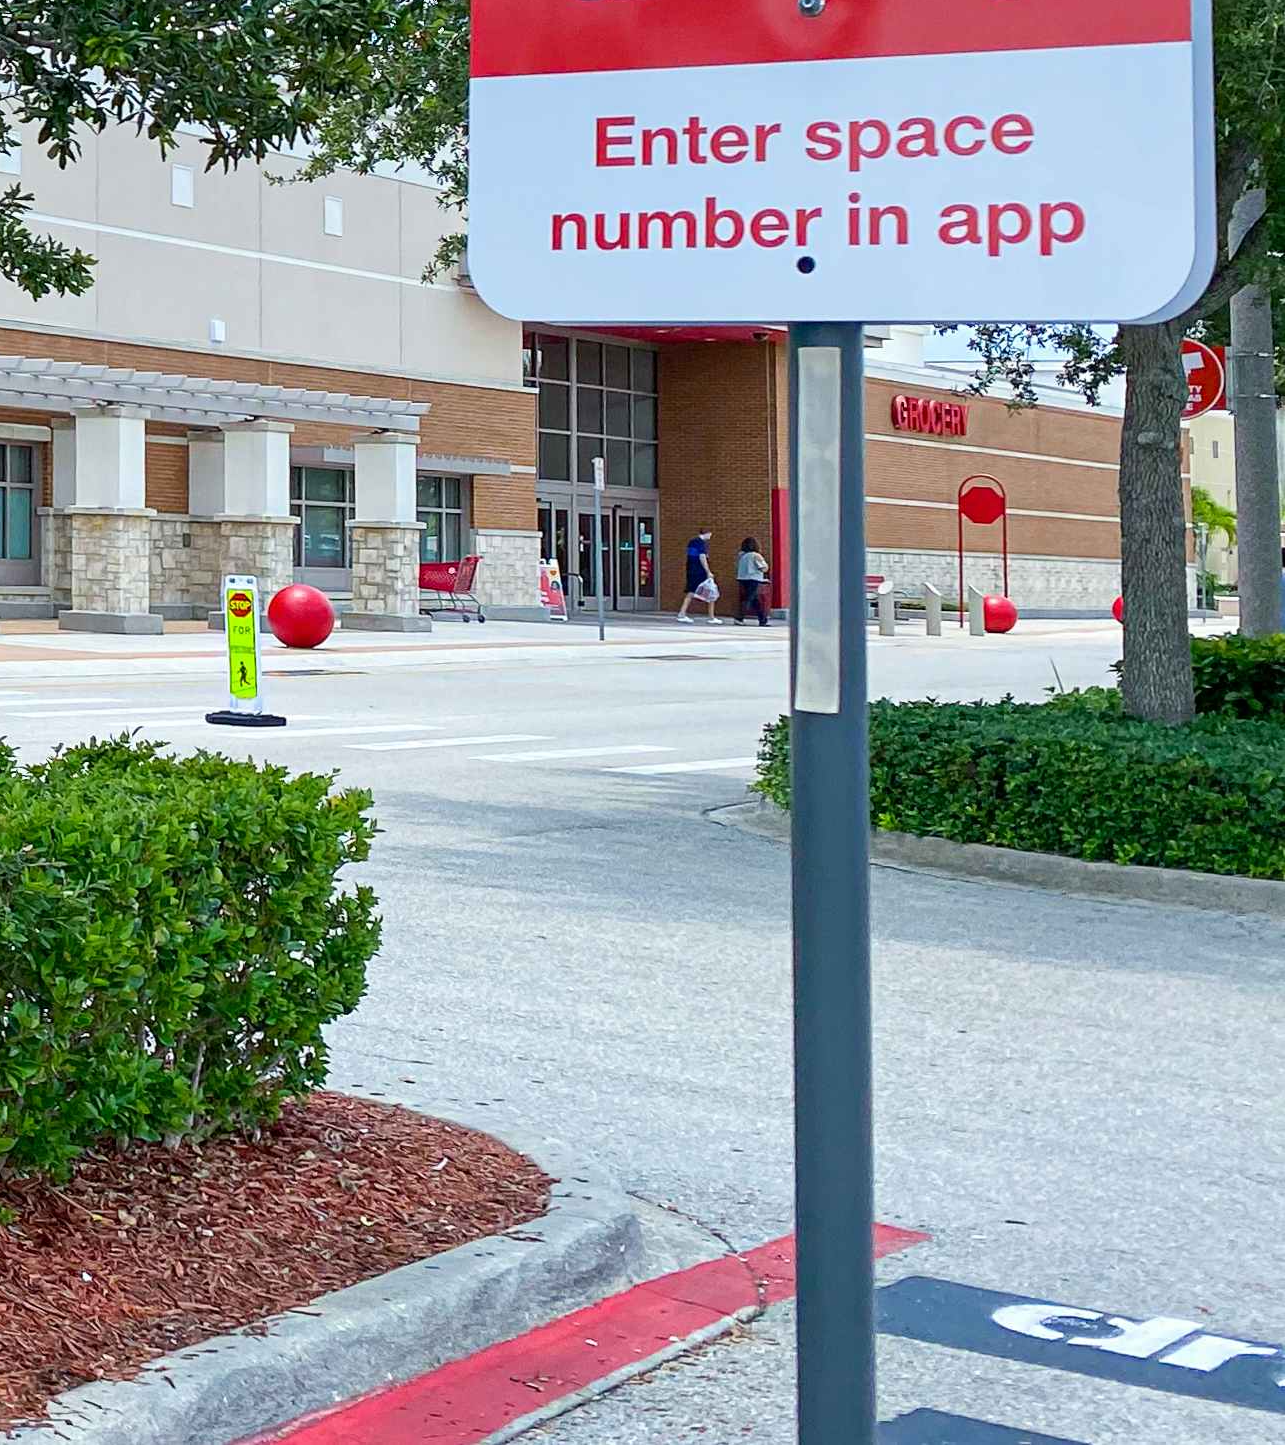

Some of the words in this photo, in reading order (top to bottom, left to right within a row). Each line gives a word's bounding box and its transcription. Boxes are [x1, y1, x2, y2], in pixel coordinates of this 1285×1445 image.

[594, 115, 781, 167] Enter
[805, 112, 1035, 172] space
[551, 197, 822, 251] number
[848, 193, 909, 246] in
[937, 202, 1086, 256] app
[891, 394, 968, 435] GROCERY
[230, 600, 251, 611] STOP
[991, 1303, 1285, 1380] dr
